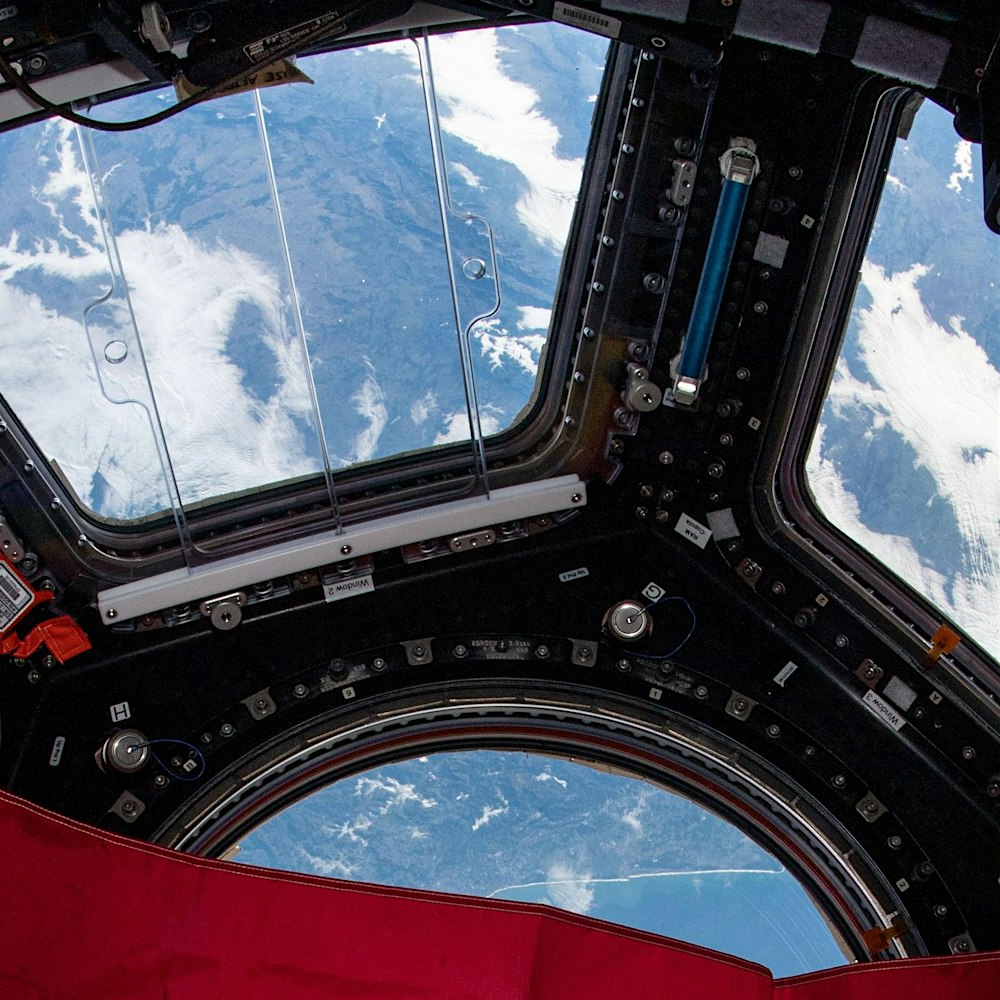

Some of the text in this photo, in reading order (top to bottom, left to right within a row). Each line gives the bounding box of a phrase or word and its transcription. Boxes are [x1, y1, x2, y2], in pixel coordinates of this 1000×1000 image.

[684, 528, 698, 540] RAM
[686, 519, 704, 535] Cupola
[328, 579, 370, 596] Window 2
[646, 585, 661, 599] G
[114, 704, 128, 720] H
[872, 698, 898, 725] Window
